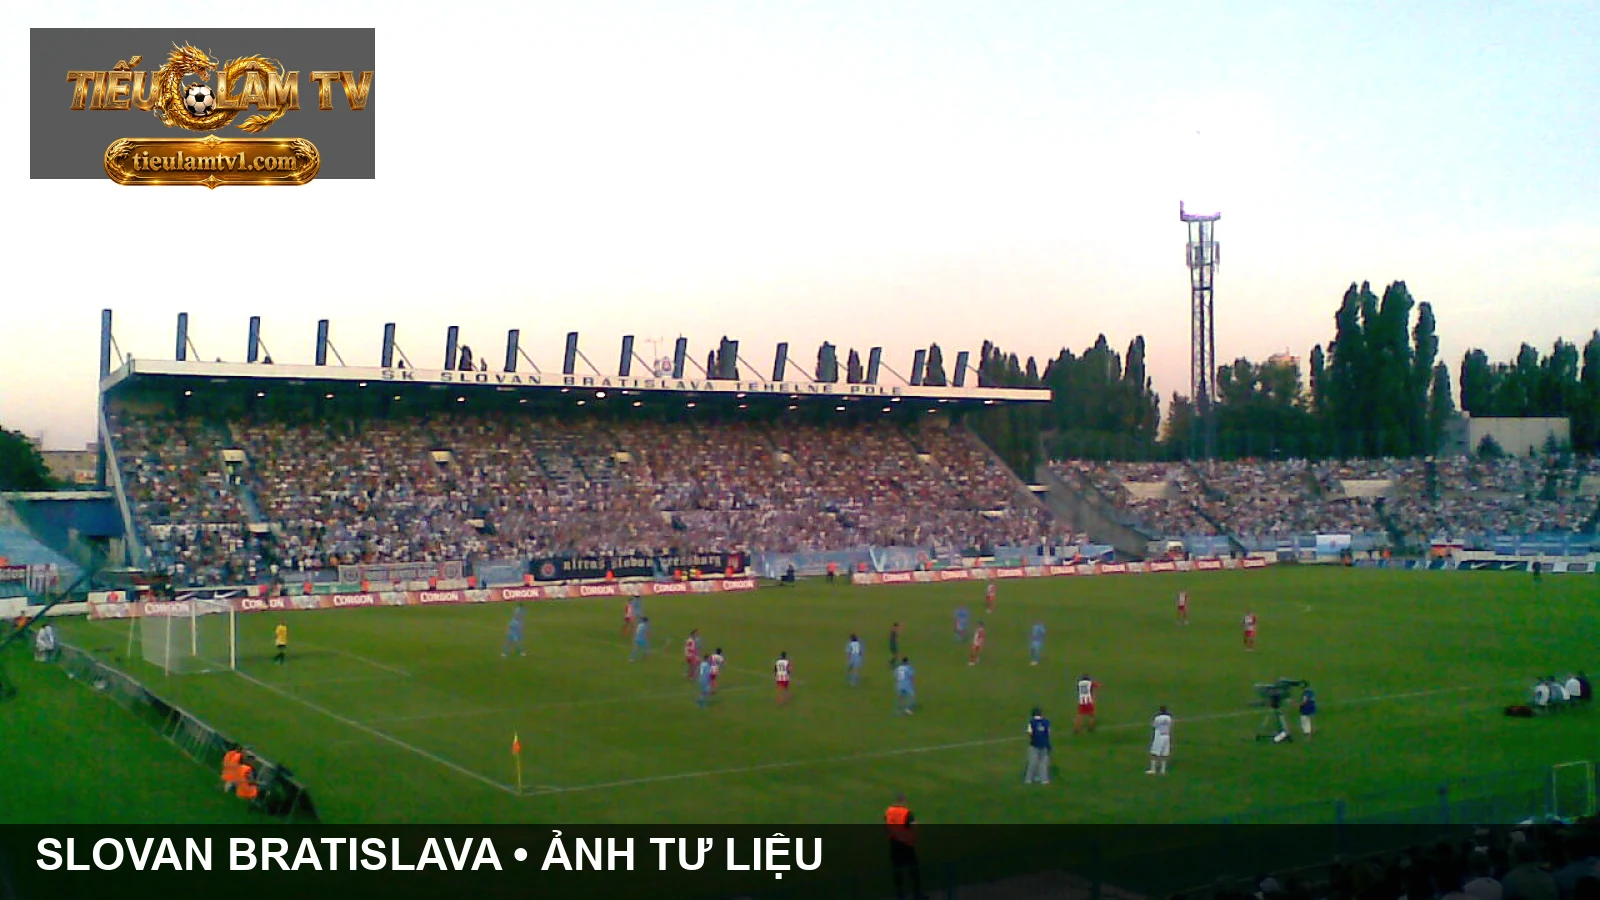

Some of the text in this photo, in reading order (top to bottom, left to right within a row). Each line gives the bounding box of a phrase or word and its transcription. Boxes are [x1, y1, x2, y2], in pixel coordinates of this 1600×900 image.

[381, 369, 415, 381] SK
[440, 371, 542, 384] SLOVAN
[563, 376, 714, 390] BRATISLAVA
[850, 385, 902, 395] POLE
[653, 582, 687, 593] CORGON
[420, 592, 459, 603] CORGON
[502, 588, 540, 600] CORGON
[333, 595, 374, 606] CORGON
